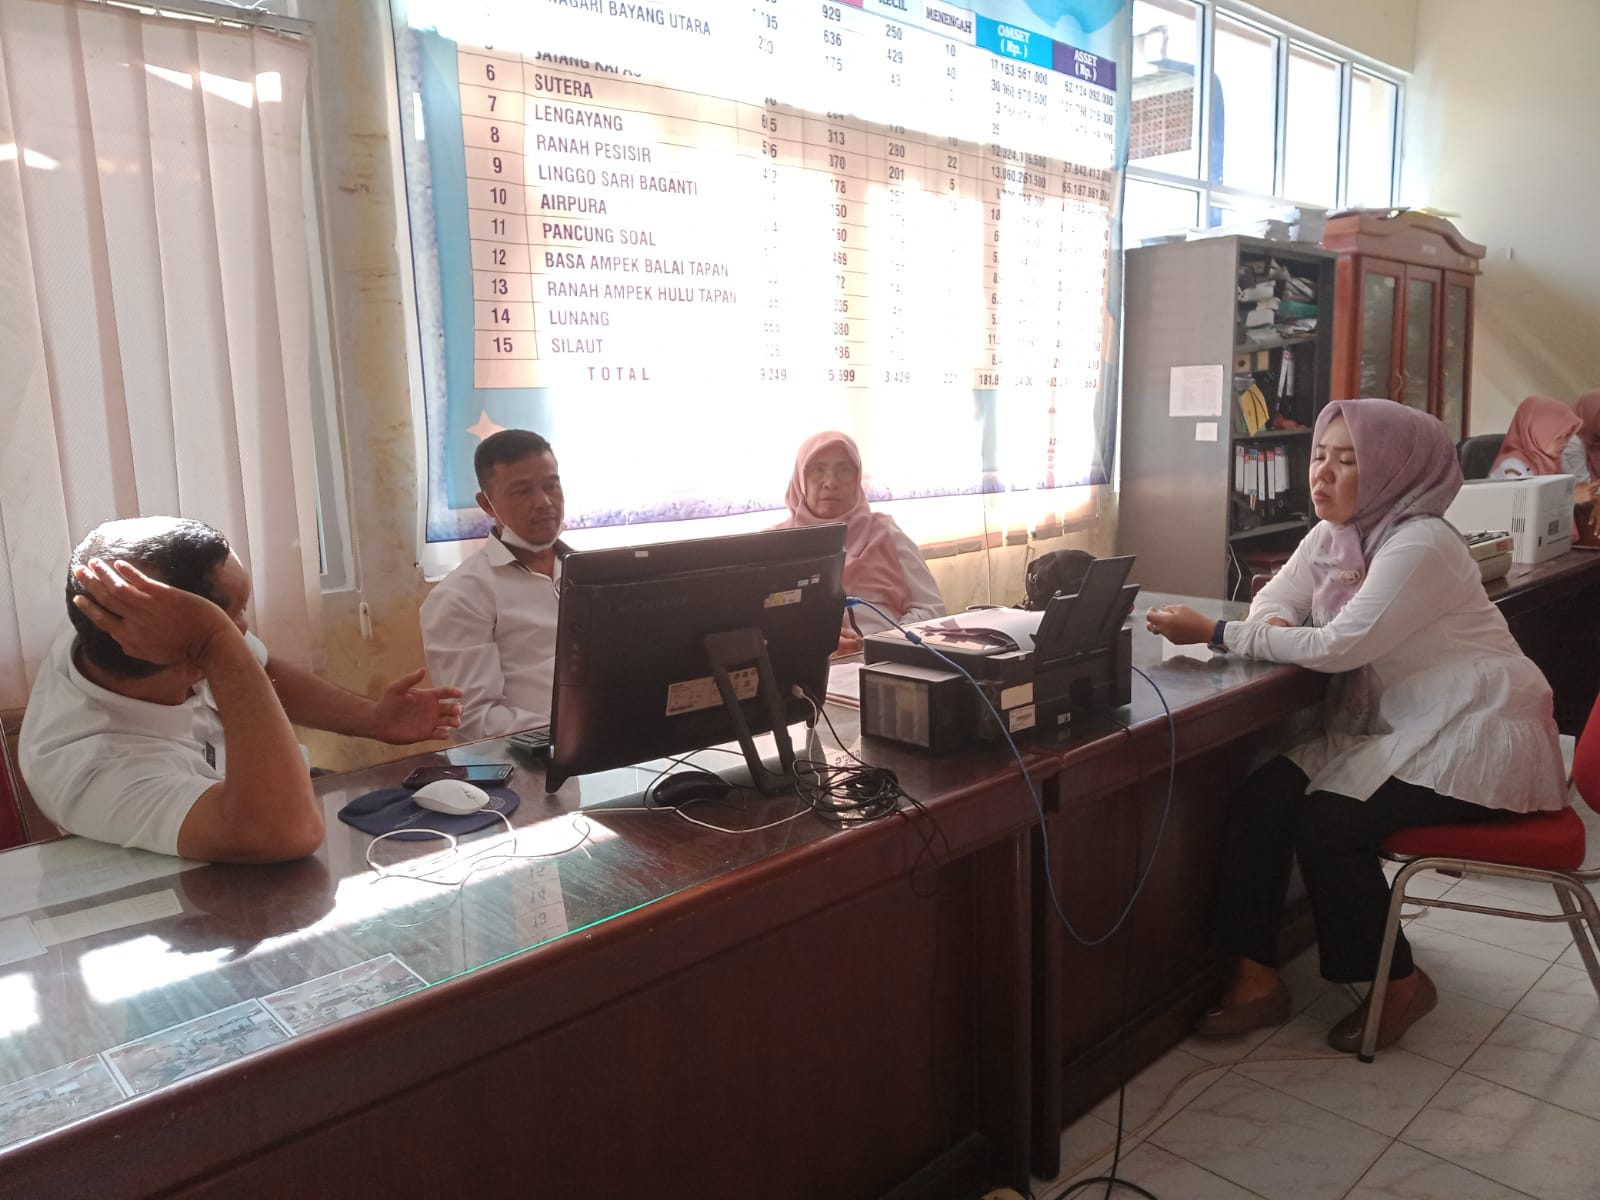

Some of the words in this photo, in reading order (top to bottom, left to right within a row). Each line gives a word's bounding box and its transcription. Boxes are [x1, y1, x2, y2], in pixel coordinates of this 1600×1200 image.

[549, 0, 603, 14] GARI
[609, 0, 664, 26] BAYANG
[669, 13, 711, 36] UTARA
[822, 4, 841, 22] 929
[885, 24, 902, 40] 250
[945, 44, 956, 57] 10
[925, 6, 972, 33] MENENGAH
[823, 29, 842, 47] 636
[997, 24, 1031, 43] OMSET
[1074, 49, 1098, 67] ASSET
[486, 64, 495, 81] 6
[534, 73, 593, 99] SUTERA
[827, 129, 845, 146] 313
[947, 155, 958, 169] 22
[488, 95, 497, 112] 7
[535, 104, 623, 131] LENGAYANG
[828, 154, 845, 170] 370
[888, 166, 905, 181] 201
[490, 126, 500, 143] 8
[536, 134, 589, 156] RANAH
[595, 142, 651, 164] PESISIR
[493, 157, 502, 174] 9
[538, 164, 596, 185] LINGGO
[601, 171, 634, 189] SARI
[639, 175, 697, 195] BAGANTI
[490, 187, 507, 205] 10
[540, 193, 607, 215] AIRPURA
[491, 218, 506, 235] 11
[542, 223, 614, 243] PANCUNG
[619, 229, 656, 246] SOAL
[492, 249, 506, 265] 12
[545, 252, 585, 270] BASA
[590, 255, 639, 272] AMPEK
[644, 258, 684, 275] BALAI
[688, 261, 728, 277] TAPAN
[491, 278, 508, 295] 13
[547, 281, 598, 298] RANAH
[604, 284, 652, 300] AMPEK
[658, 287, 694, 302] HULU
[698, 288, 736, 303] TAPAN
[491, 308, 511, 324] 14
[549, 310, 610, 326] LUNANG
[493, 337, 513, 353] 15
[551, 338, 603, 353] SILAUT
